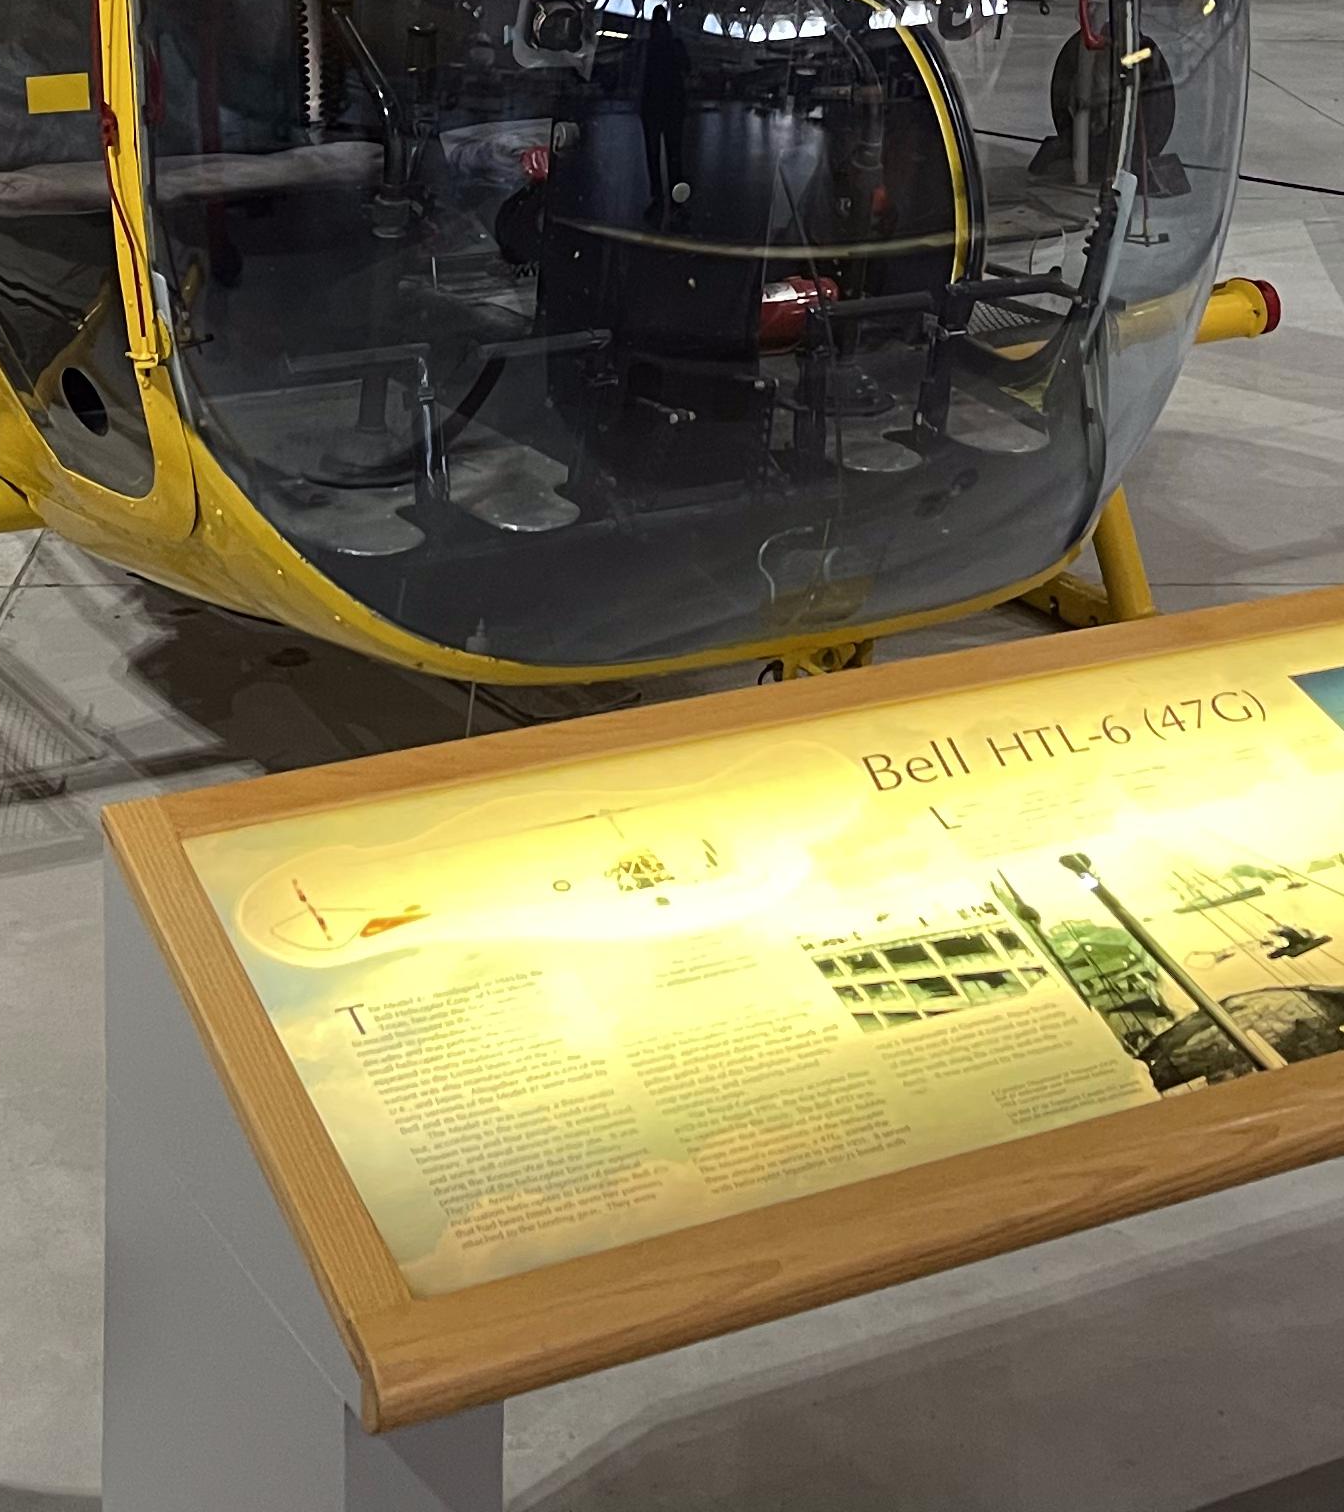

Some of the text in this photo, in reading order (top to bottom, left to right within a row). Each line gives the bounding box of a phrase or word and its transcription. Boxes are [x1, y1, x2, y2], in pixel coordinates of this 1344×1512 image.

[861, 688, 1268, 792] Bell HTL-6 (47G)
